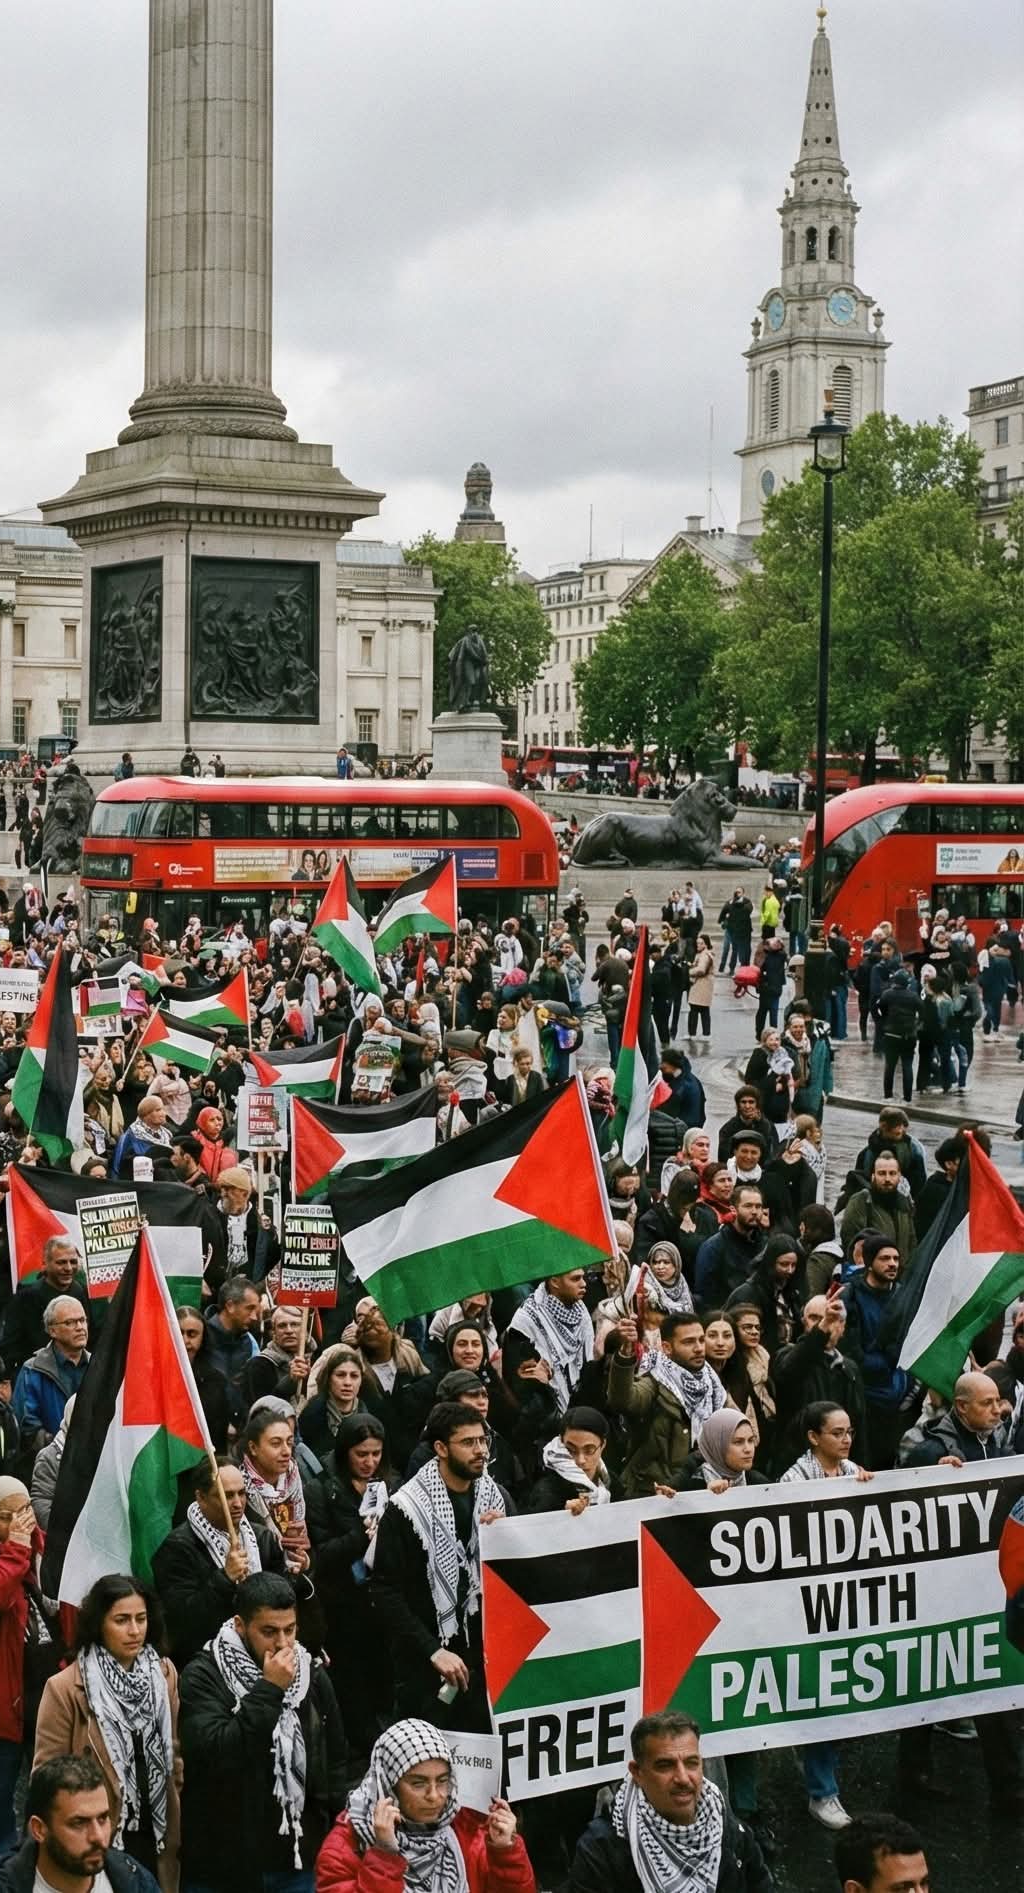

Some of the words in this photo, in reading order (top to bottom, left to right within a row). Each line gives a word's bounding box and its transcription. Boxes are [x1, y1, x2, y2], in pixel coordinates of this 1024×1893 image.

[709, 1489, 999, 1577] SOLIDARITY
[800, 1571, 917, 1635] WITH
[710, 1621, 1002, 1722] PALESTINE
[498, 1699, 626, 1788] FREE
